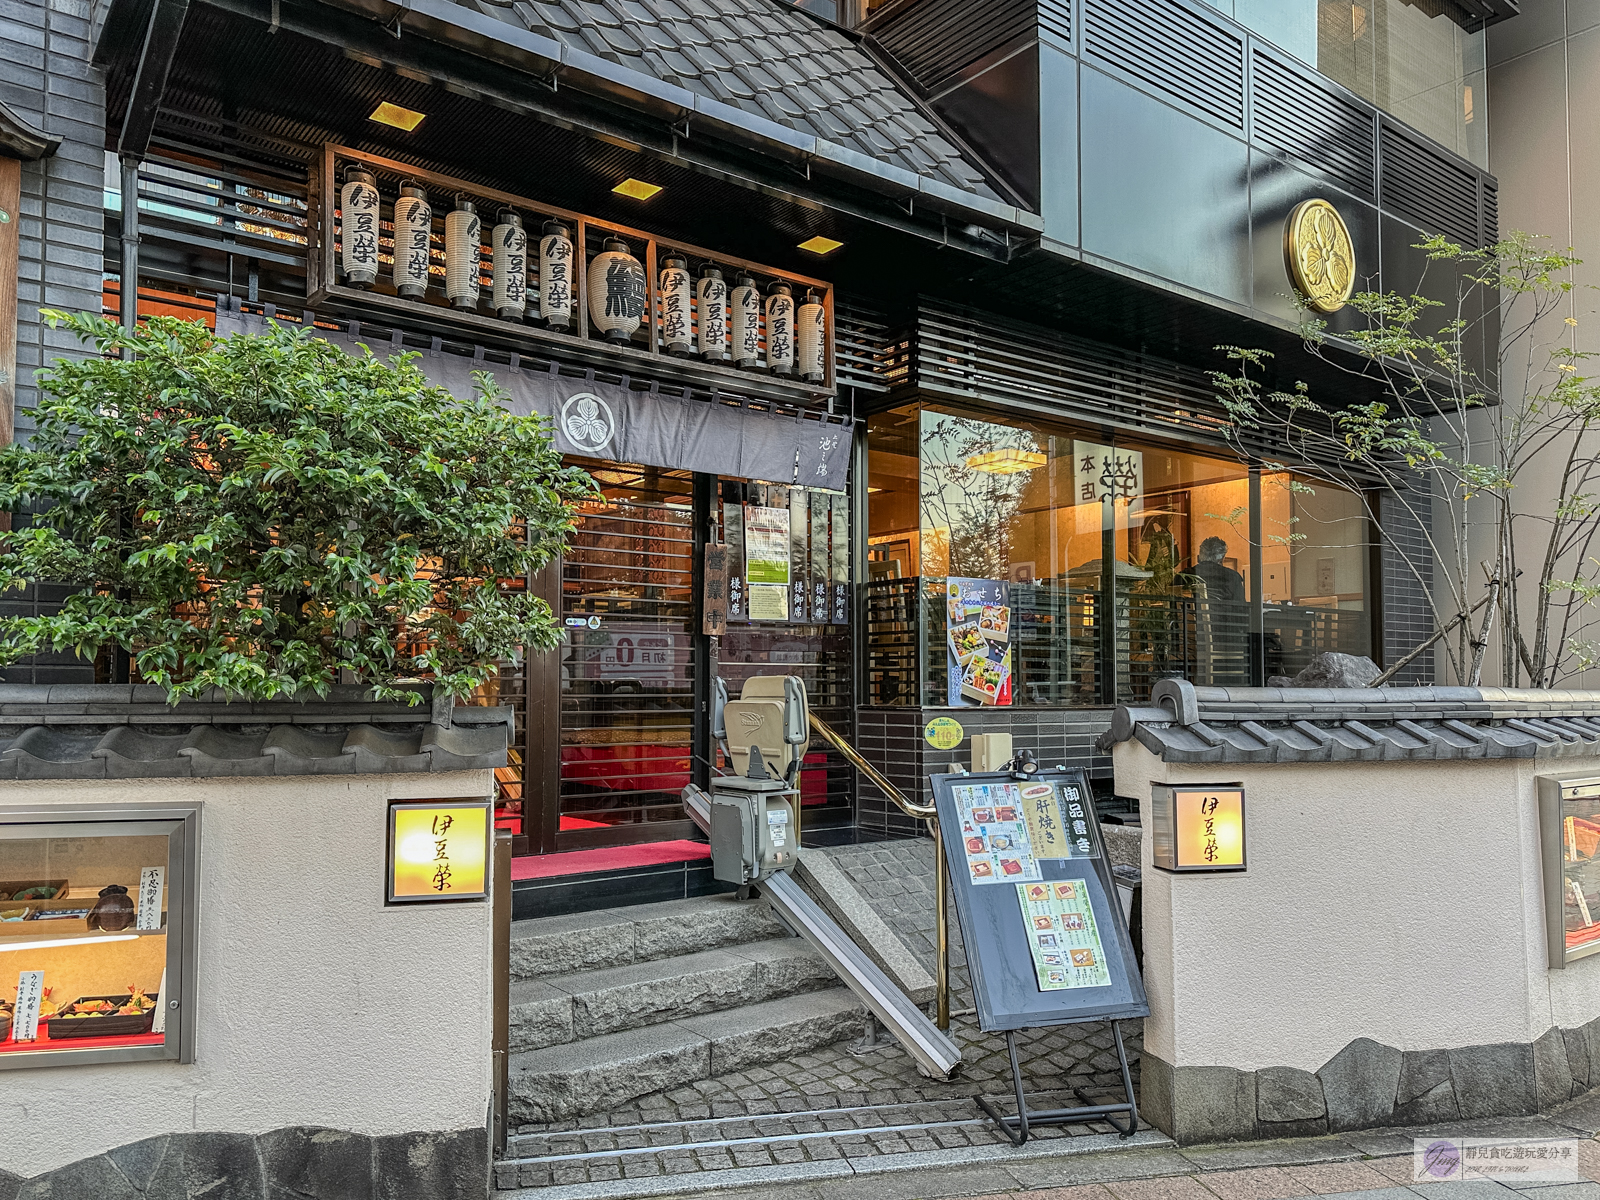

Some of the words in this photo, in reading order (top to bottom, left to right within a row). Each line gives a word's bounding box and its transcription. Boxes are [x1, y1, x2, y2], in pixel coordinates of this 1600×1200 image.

[962, 586, 1002, 601] おせち
[1036, 799, 1056, 844] 肝焼き
[1063, 786, 1091, 853] 御品書き
